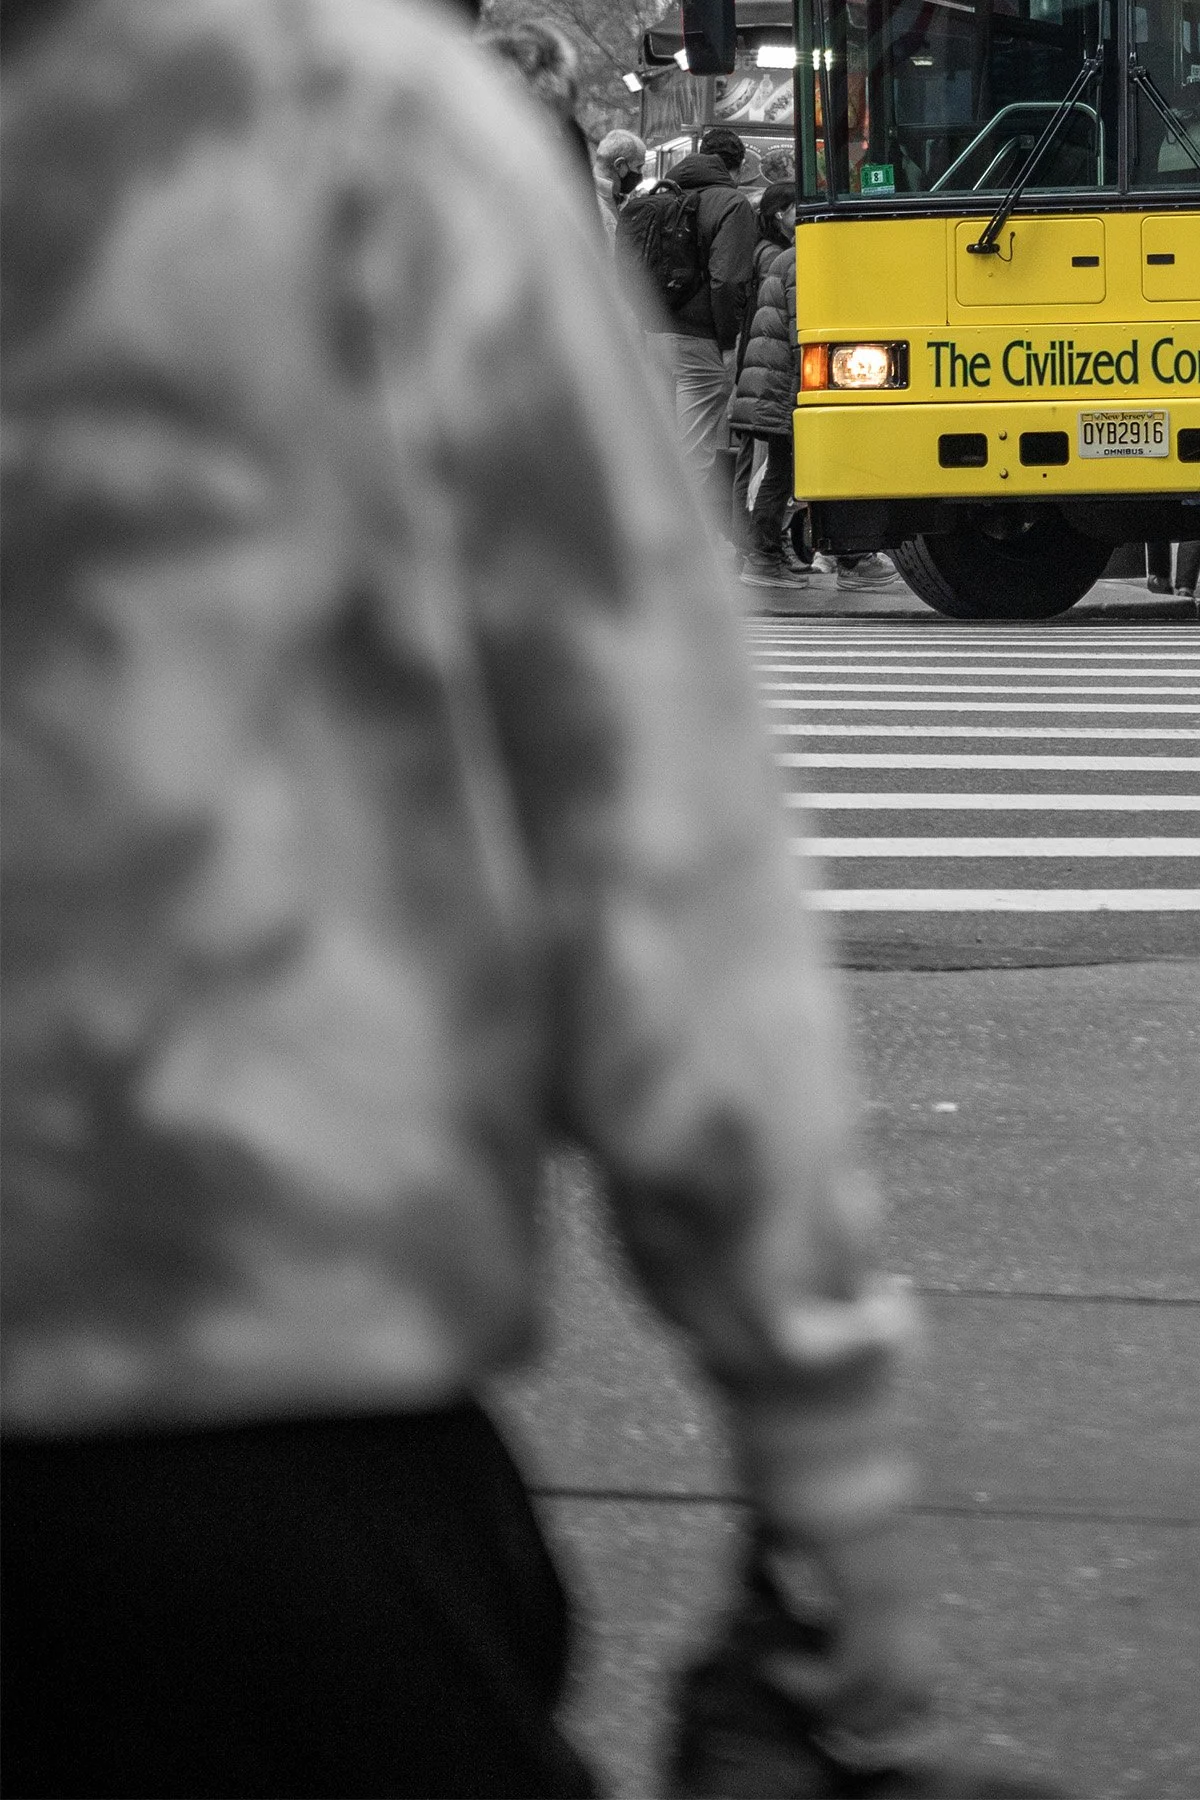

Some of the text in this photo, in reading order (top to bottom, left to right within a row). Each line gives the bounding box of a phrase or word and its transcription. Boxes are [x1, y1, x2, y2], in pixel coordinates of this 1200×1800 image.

[926, 340, 991, 388] The
[1001, 338, 1139, 387] Civilized
[1099, 412, 1146, 422] New Jersey
[1103, 448, 1144, 456] OMNIBUS
